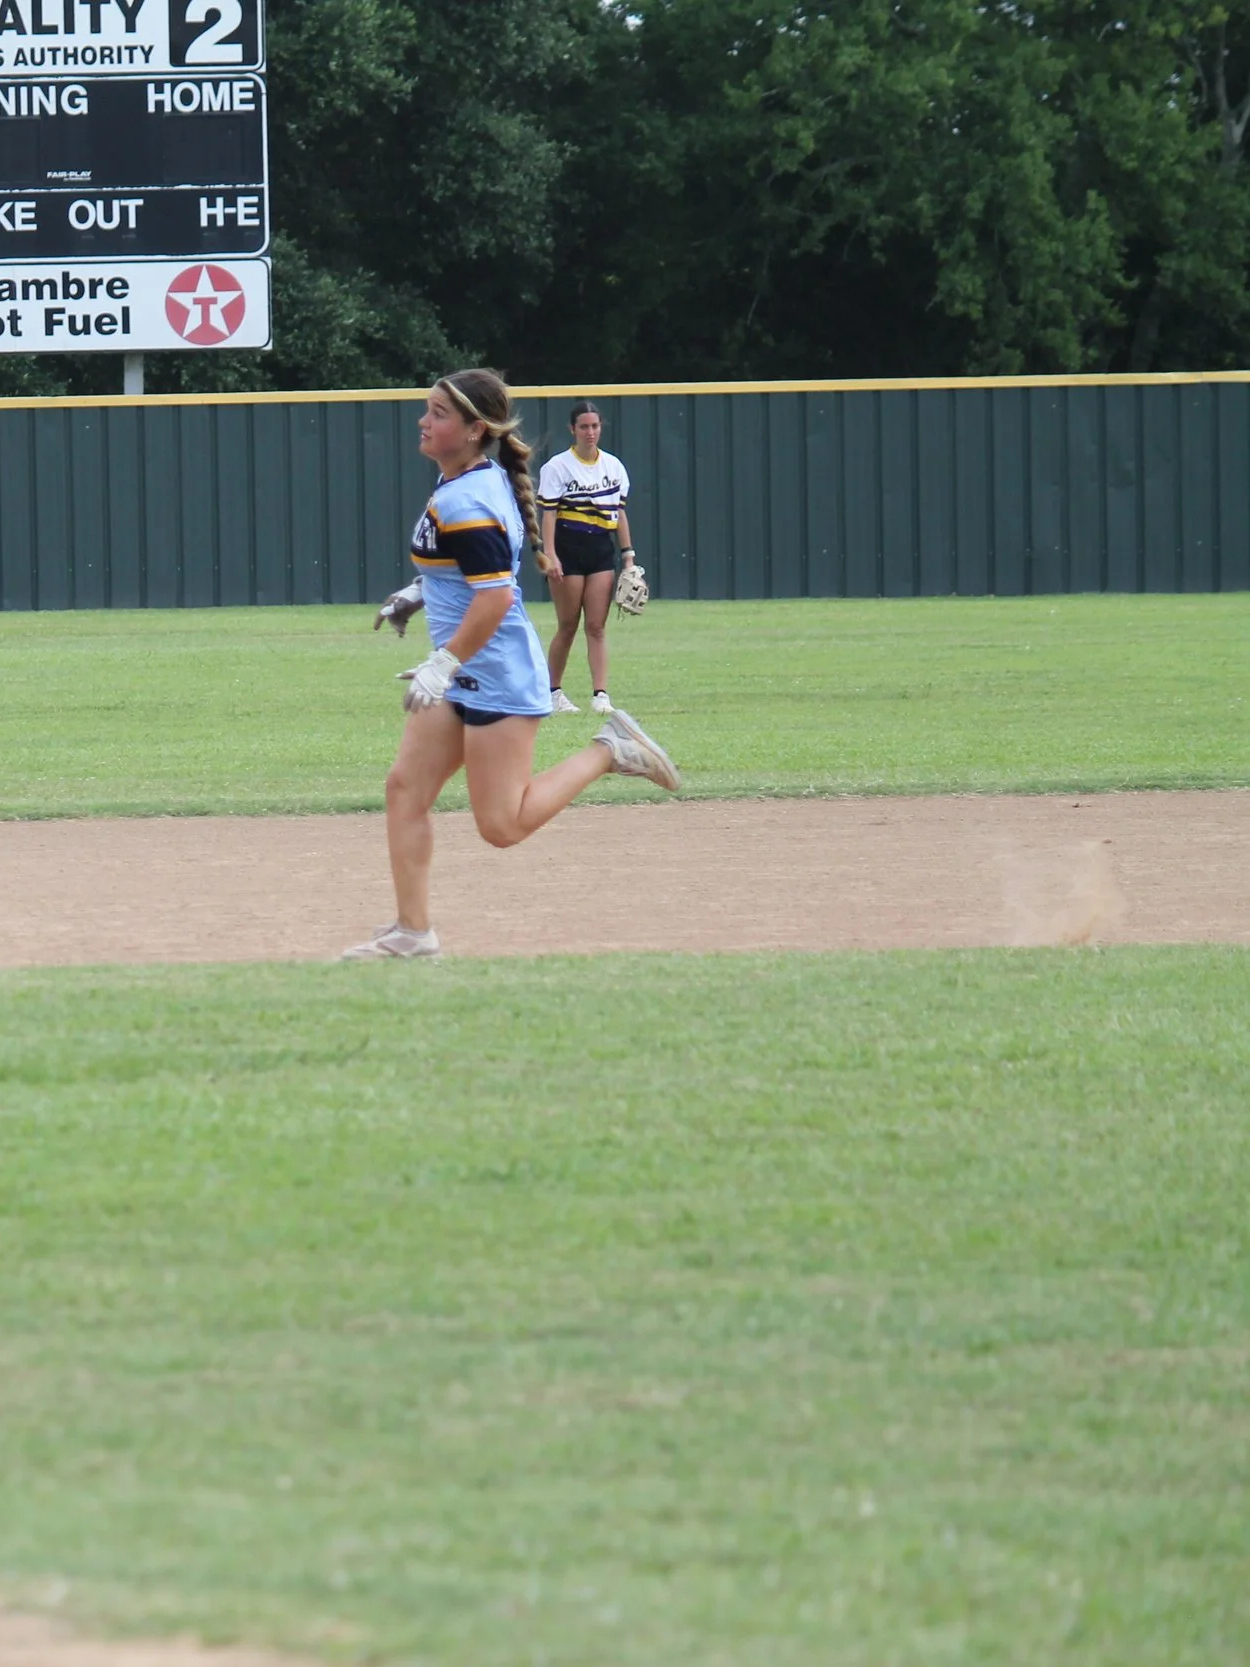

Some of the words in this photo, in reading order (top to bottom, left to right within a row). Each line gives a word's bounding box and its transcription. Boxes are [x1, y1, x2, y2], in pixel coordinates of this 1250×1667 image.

[184, 0, 244, 63] 2
[13, 44, 154, 66] AUTHORITY
[147, 81, 255, 113] HOME
[68, 199, 144, 230] OUT
[45, 306, 131, 336] Fuel
